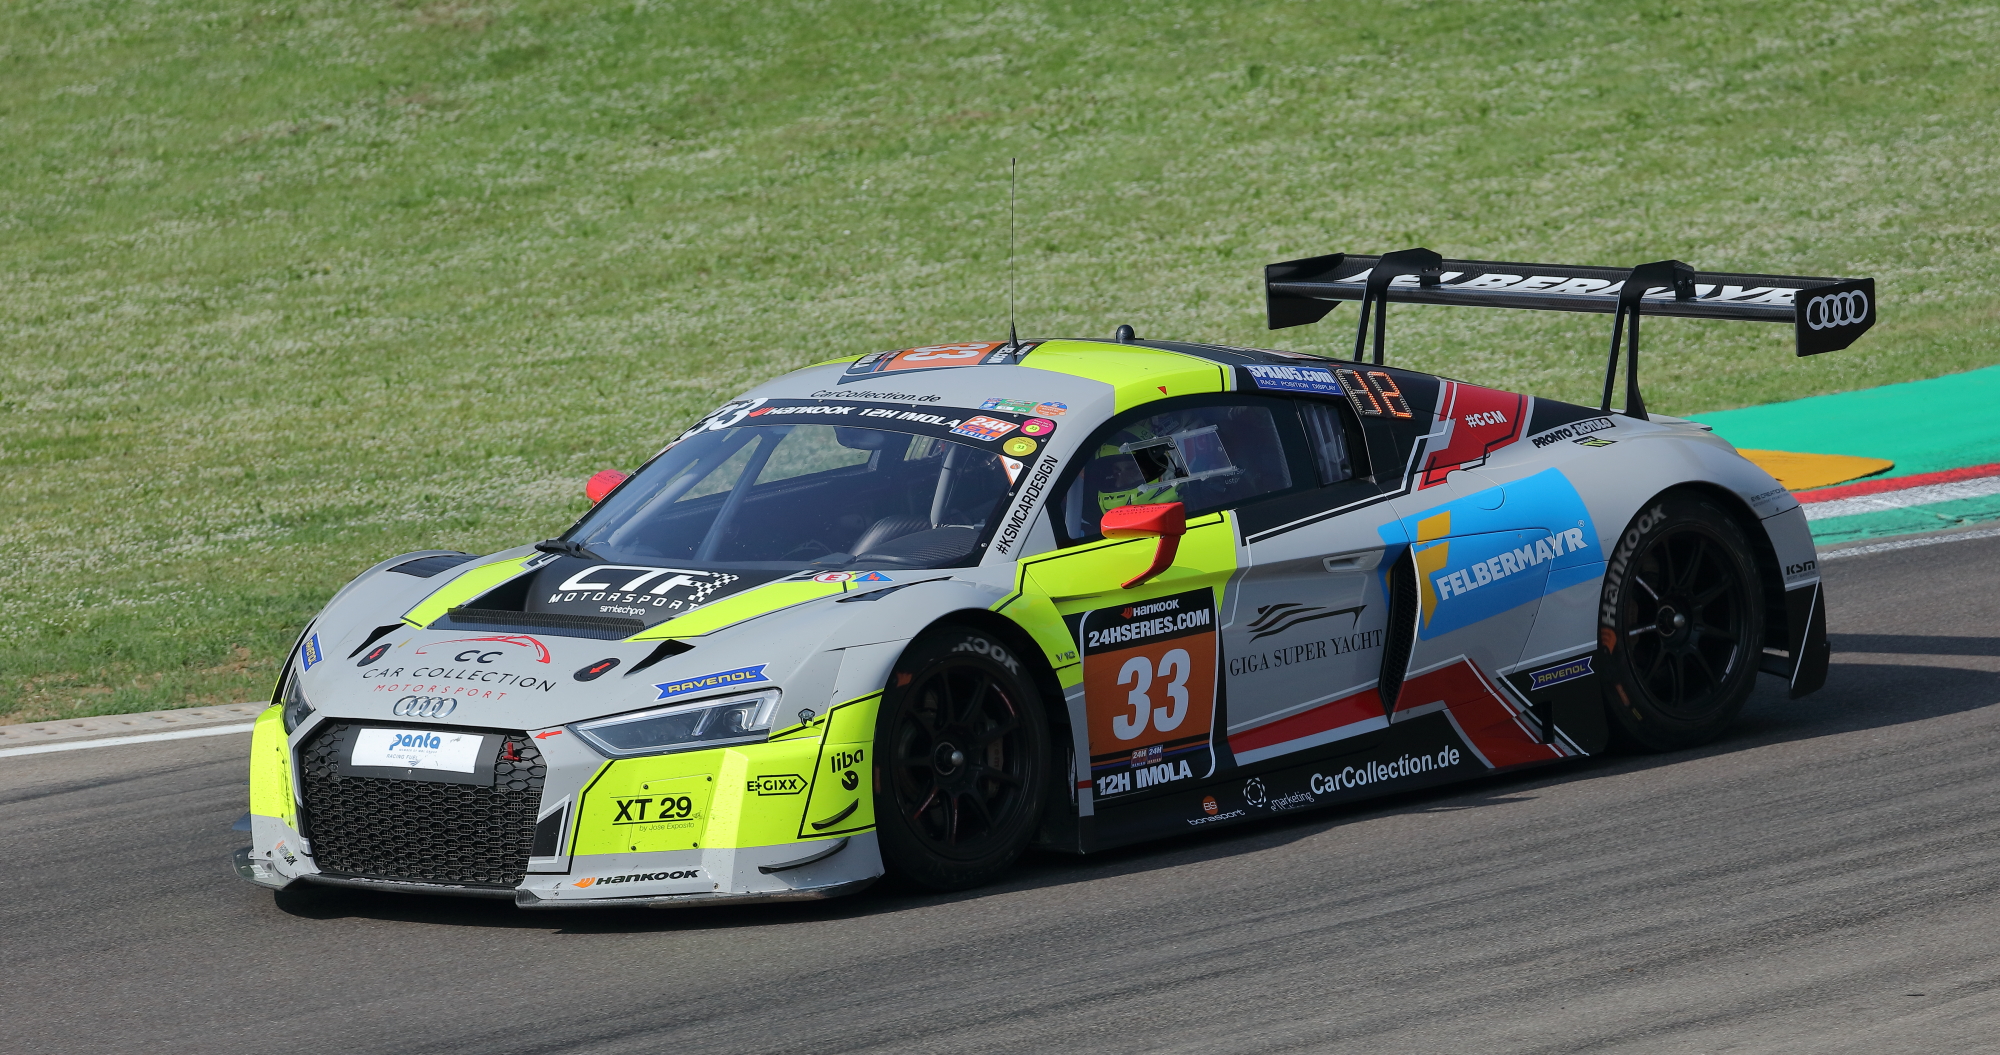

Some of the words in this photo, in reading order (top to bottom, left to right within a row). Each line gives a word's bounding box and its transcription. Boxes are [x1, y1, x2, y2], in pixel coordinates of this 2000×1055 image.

[1259, 379, 1278, 387] RACE
[1280, 381, 1309, 389] POSITION
[1311, 383, 1337, 391] DISPLAY
[810, 389, 942, 402] CarCollection.de
[858, 408, 901, 418] 12H
[896, 411, 962, 428] IMOLA
[969, 416, 1013, 432] 24H
[1465, 410, 1508, 428] #CCM
[953, 428, 993, 441] SERIES
[962, 424, 1002, 435] GT
[1531, 427, 1574, 449] PRONTO
[996, 455, 1058, 555] #KSMCARDESIGN
[1435, 526, 1589, 601] FELBERMAYR
[1786, 560, 1816, 575] KSM
[547, 591, 700, 611] MOTORSPORT
[1088, 608, 1210, 648] 24HSERIES.COM
[454, 649, 504, 664] CC
[1229, 652, 1271, 677] GIGA
[1273, 640, 1327, 668] SUPER
[1330, 628, 1383, 656] YACHT
[362, 667, 405, 679] CAR
[412, 667, 557, 693] COLLECTION
[667, 671, 757, 694] RAVENOL
[1537, 664, 1586, 684] RAVENOL
[373, 684, 508, 701] MOTORSPORT
[1112, 648, 1191, 741] 33
[388, 732, 441, 751] panta
[830, 748, 864, 774] liba
[1310, 744, 1460, 795] CarCollection.de
[1096, 771, 1131, 796] 12H
[1135, 759, 1193, 789] IMOLA
[613, 798, 653, 822] XT
[658, 796, 692, 819] 29
[1203, 801, 1218, 812] BS
[638, 825, 648, 833] by
